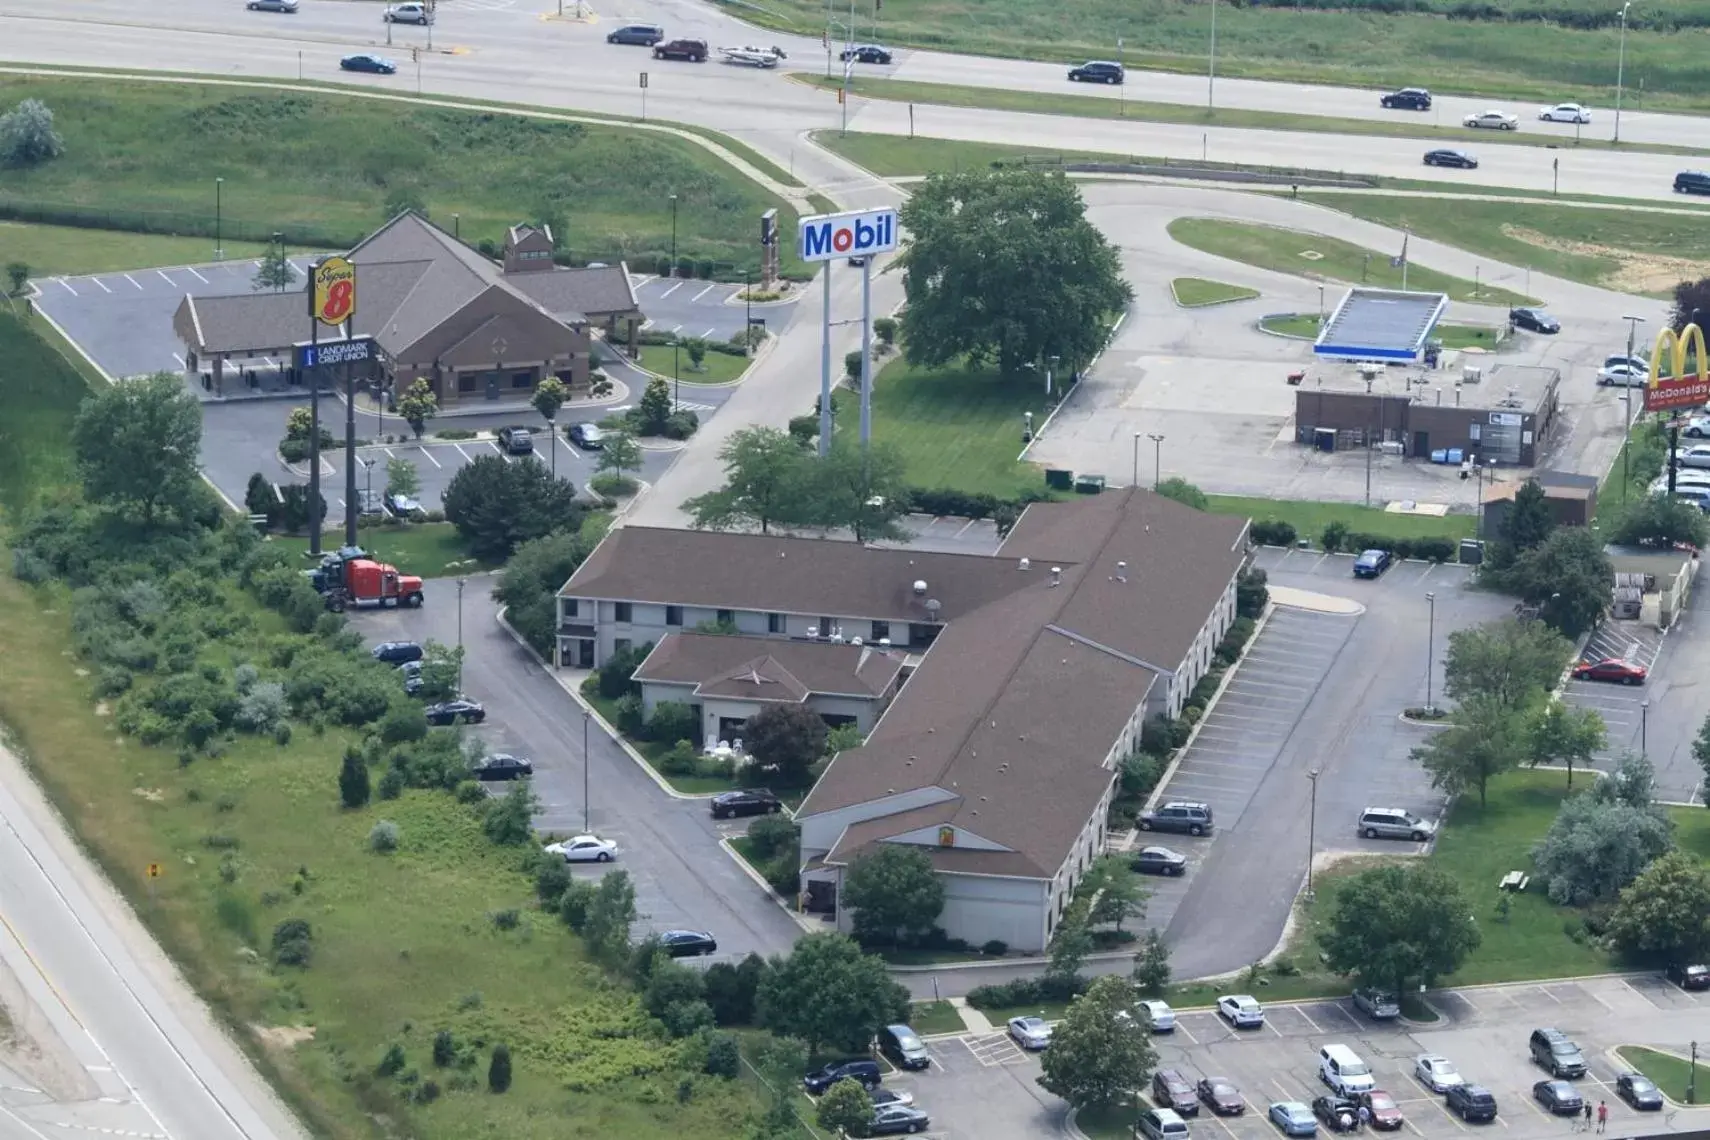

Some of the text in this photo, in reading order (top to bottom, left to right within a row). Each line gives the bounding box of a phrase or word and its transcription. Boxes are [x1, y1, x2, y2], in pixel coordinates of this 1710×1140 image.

[805, 215, 891, 256] Mobil
[323, 279, 353, 319] 8
[318, 342, 368, 357] LANDMARK
[318, 350, 368, 364] CREDIT UNION
[1650, 383, 1707, 400] McDonald's
